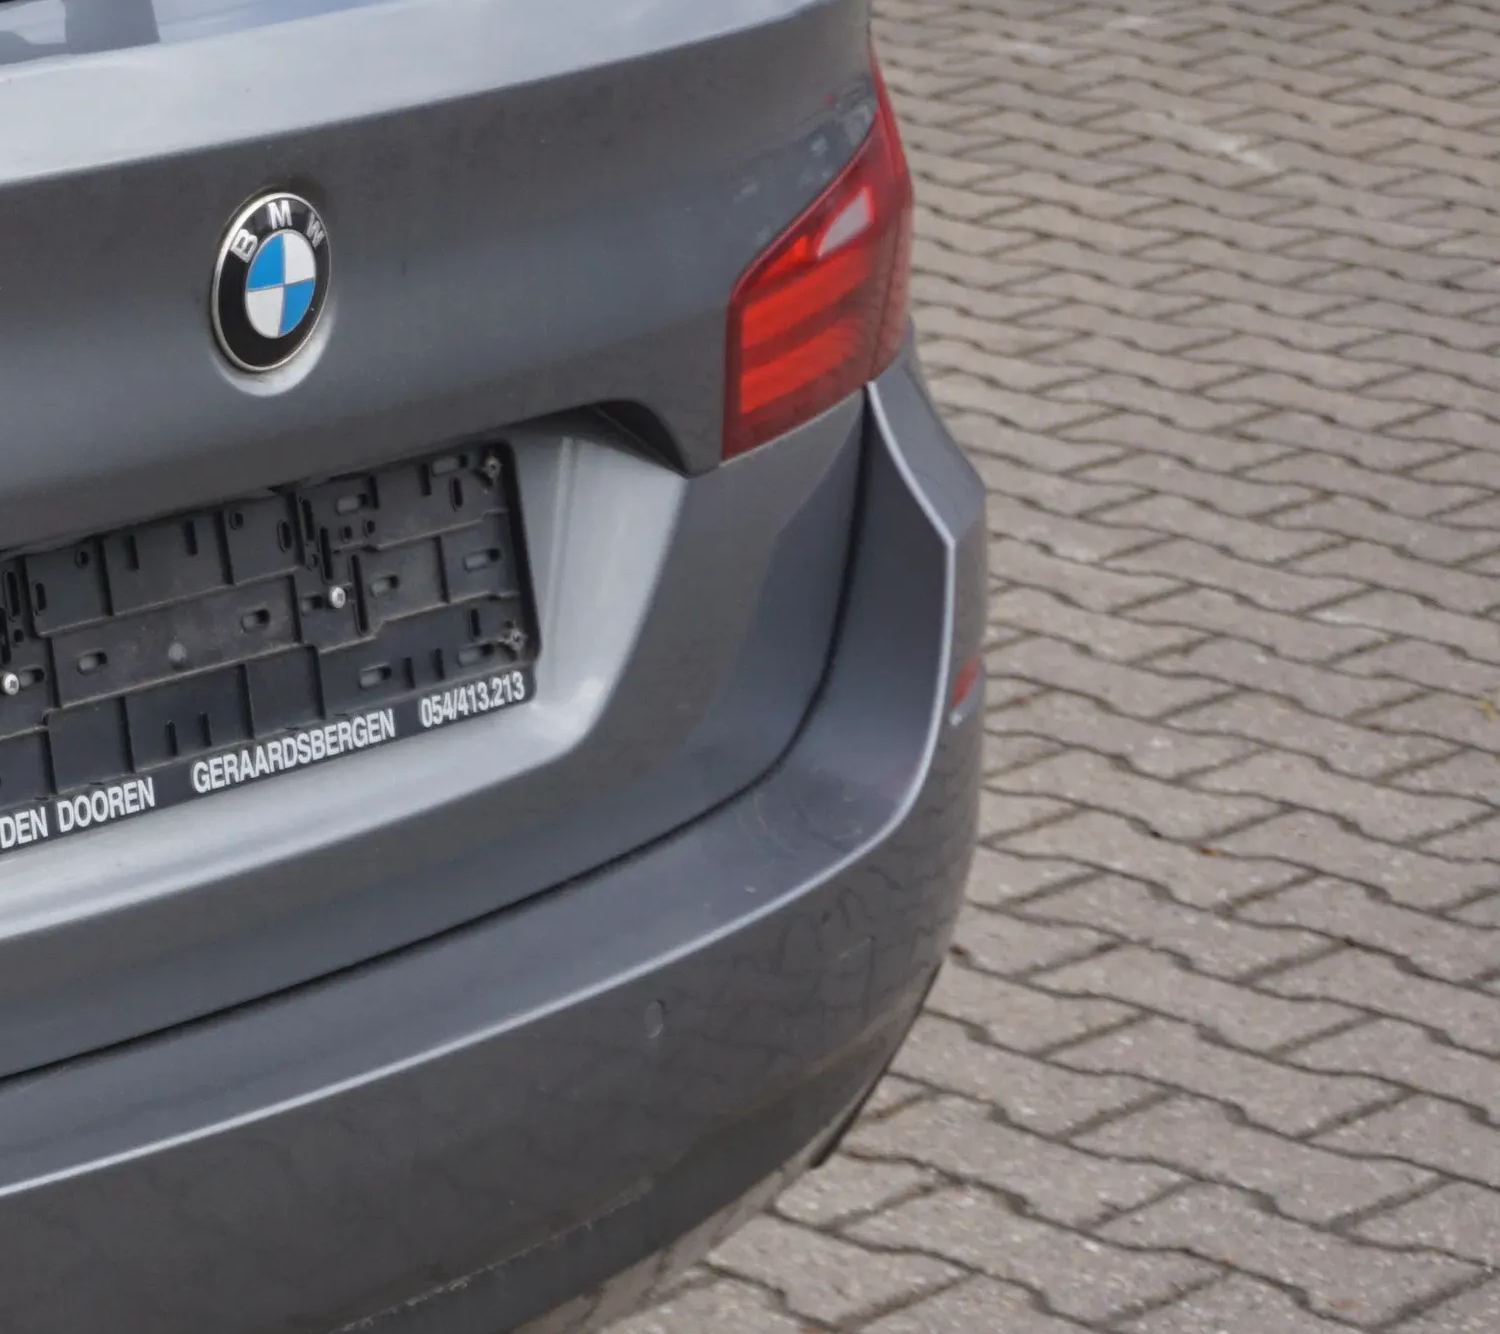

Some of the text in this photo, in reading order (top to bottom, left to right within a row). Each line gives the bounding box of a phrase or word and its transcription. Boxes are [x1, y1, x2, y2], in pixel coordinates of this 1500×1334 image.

[230, 199, 326, 264] BMW
[56, 776, 156, 834] DOOREN
[192, 708, 395, 794] GERAARDSBERGEN
[419, 670, 526, 729] 054/413.213
